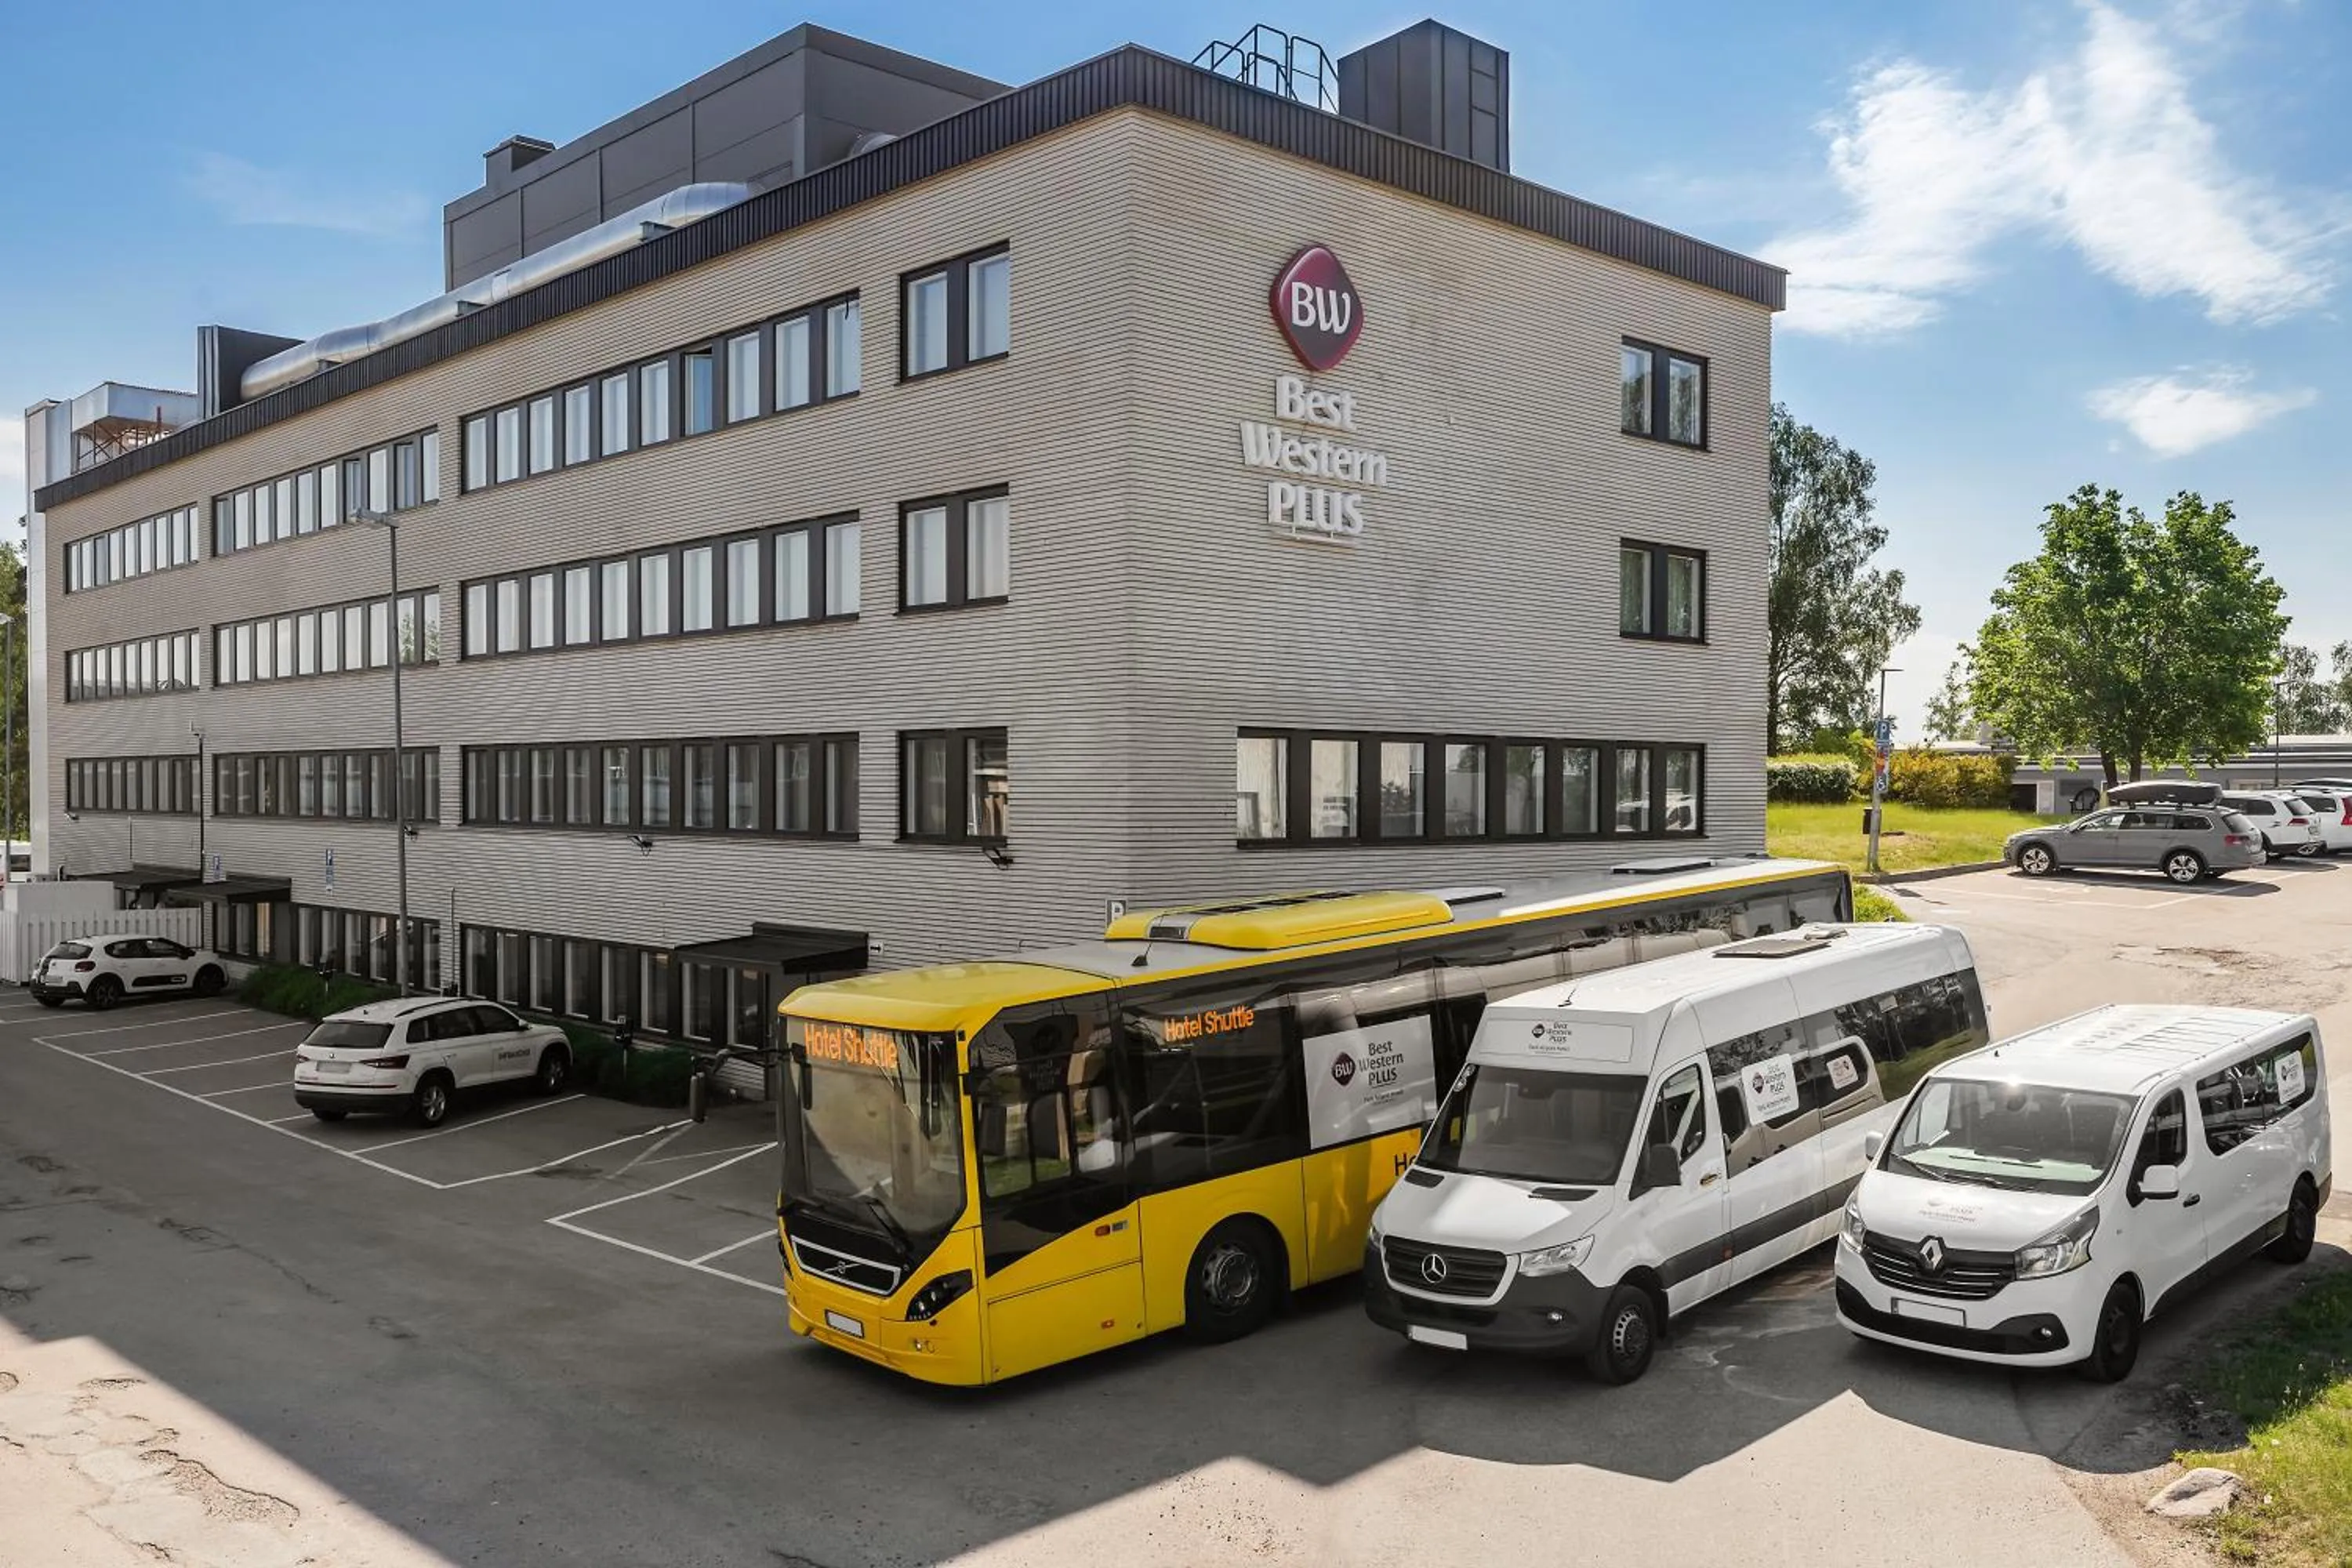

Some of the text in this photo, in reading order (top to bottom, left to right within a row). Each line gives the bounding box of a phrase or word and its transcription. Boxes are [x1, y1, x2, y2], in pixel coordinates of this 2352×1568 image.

[1291, 281, 1352, 334] BW
[1275, 376, 1357, 430] Best
[1240, 421, 1387, 486] Western
[1267, 482, 1363, 534] PLUS
[1111, 902, 1123, 923] P
[1164, 1005, 1254, 1042] Hotel Shuttle
[804, 1022, 898, 1069] Hotel Shuttle
[1358, 1053, 1404, 1073] Western
[1368, 1040, 1393, 1056] Best
[1335, 1062, 1353, 1078] BW
[1367, 1067, 1398, 1086] PLUS
